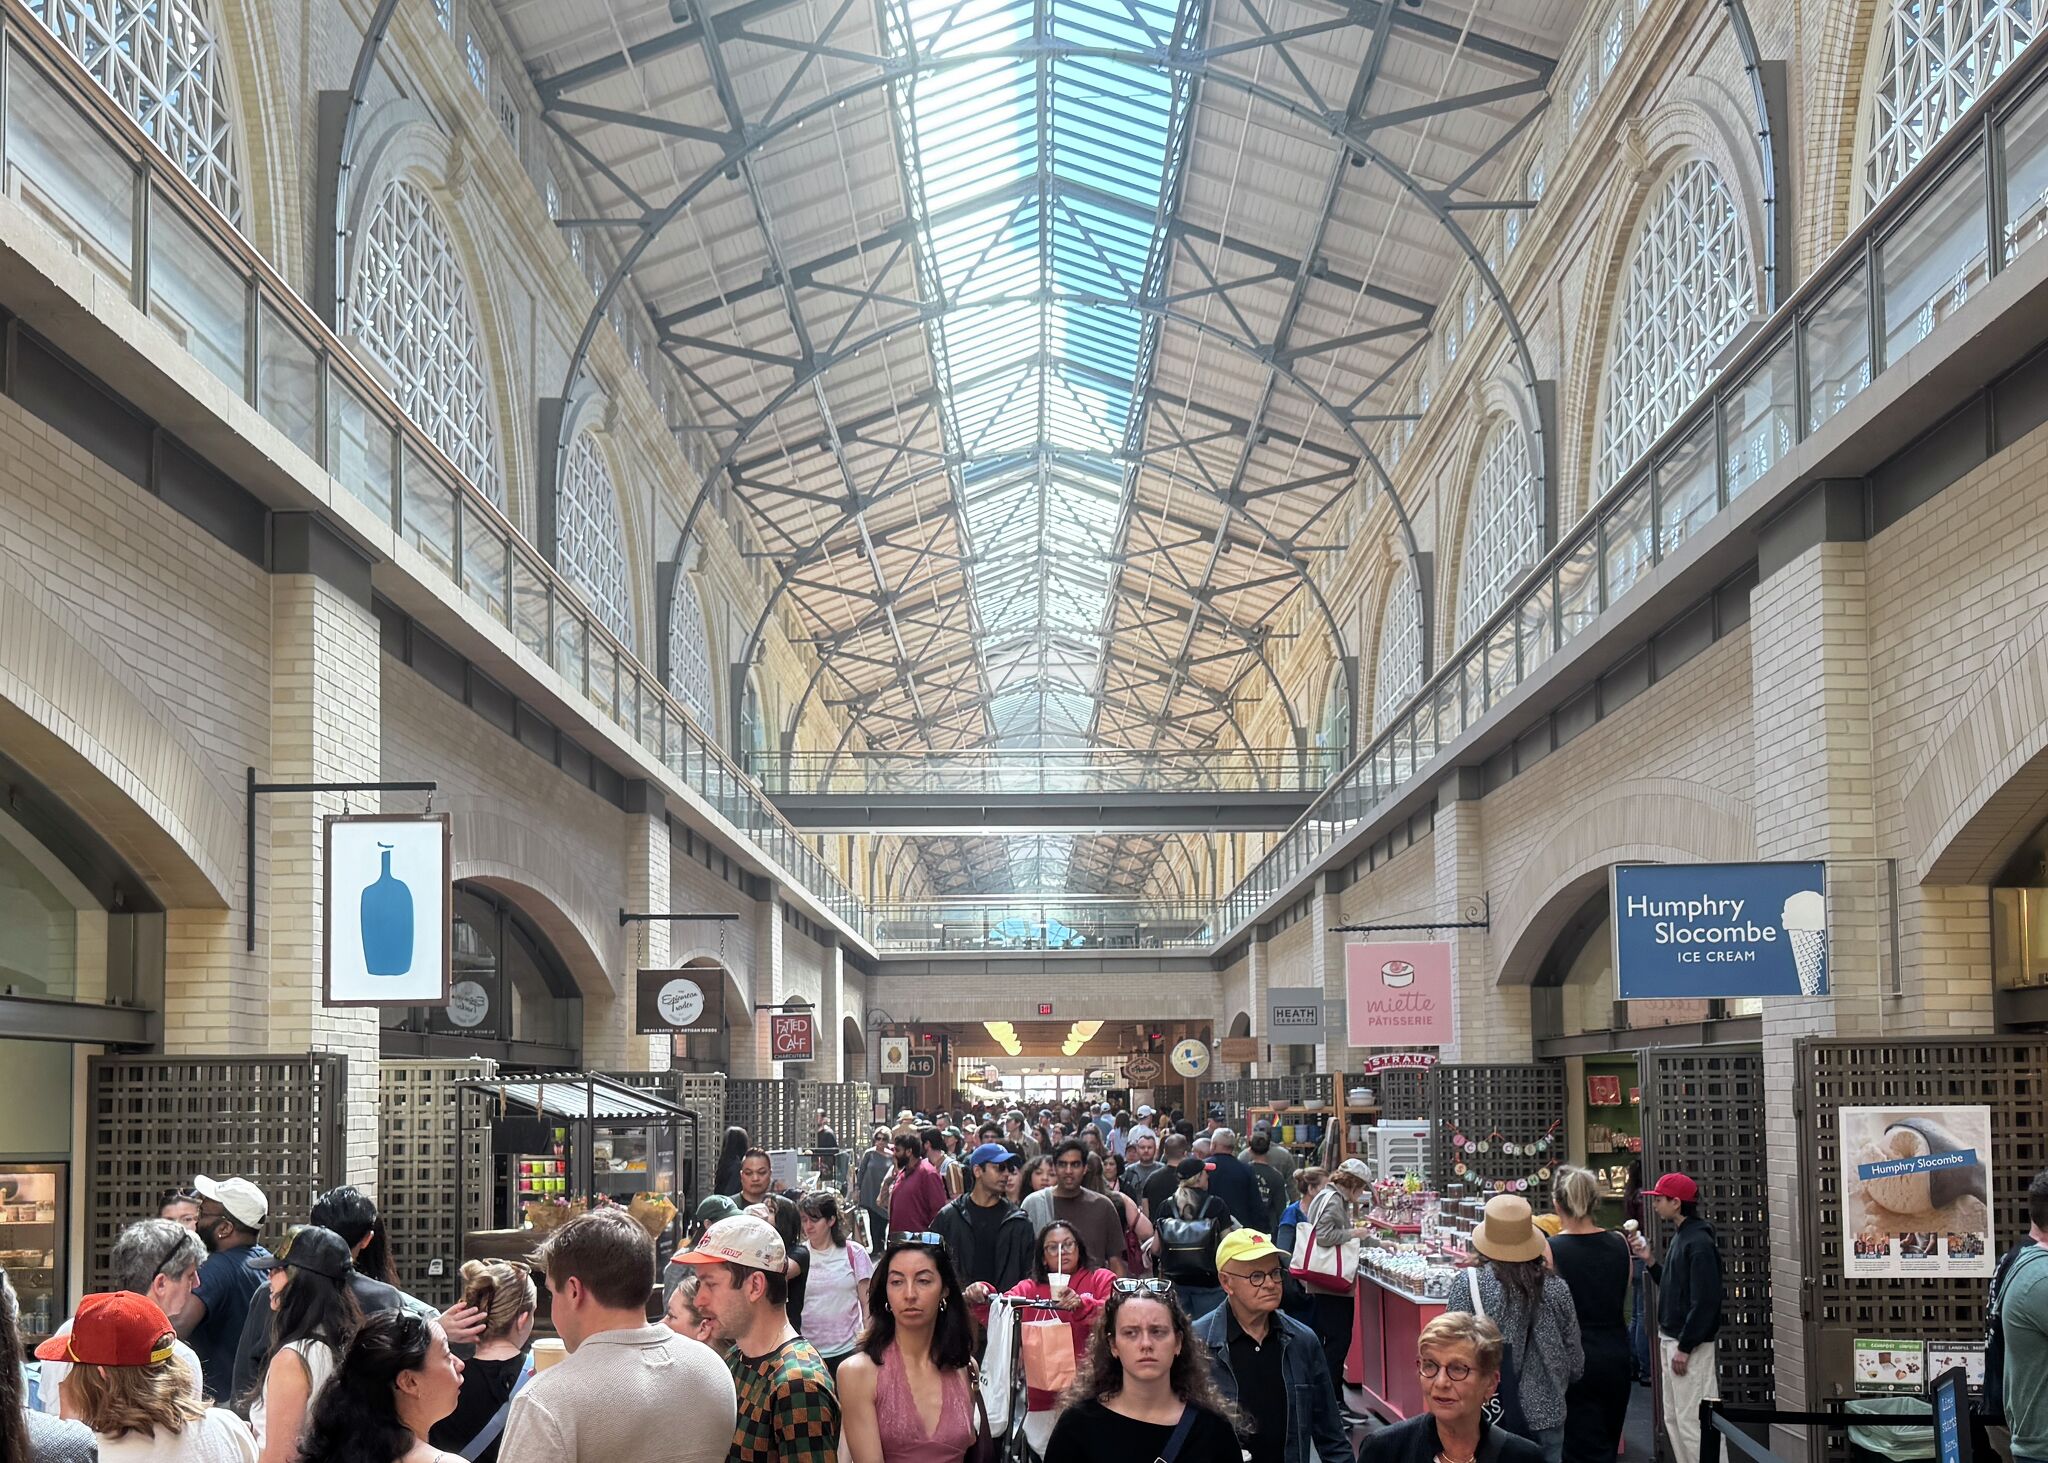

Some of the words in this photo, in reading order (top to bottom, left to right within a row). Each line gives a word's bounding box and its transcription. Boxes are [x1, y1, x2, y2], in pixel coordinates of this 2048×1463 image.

[1627, 894, 1745, 922] Humphry
[1655, 920, 1777, 944] Slocombe
[1677, 952, 1701, 963] ICE
[1706, 951, 1755, 962] CREAM
[1040, 1004, 1051, 1014] EXIT
[1366, 992, 1436, 1013] miette
[1276, 1009, 1314, 1018] HEATH
[776, 1018, 808, 1034] FATTED
[777, 1033, 807, 1051] CALF
[909, 1061, 931, 1072] A16
[1371, 1054, 1432, 1066] STRAUS
[1454, 1135, 1488, 1153] ICE
[1871, 1162, 1915, 1177] Humphry
[1917, 1154, 1964, 1168] Slocombe
